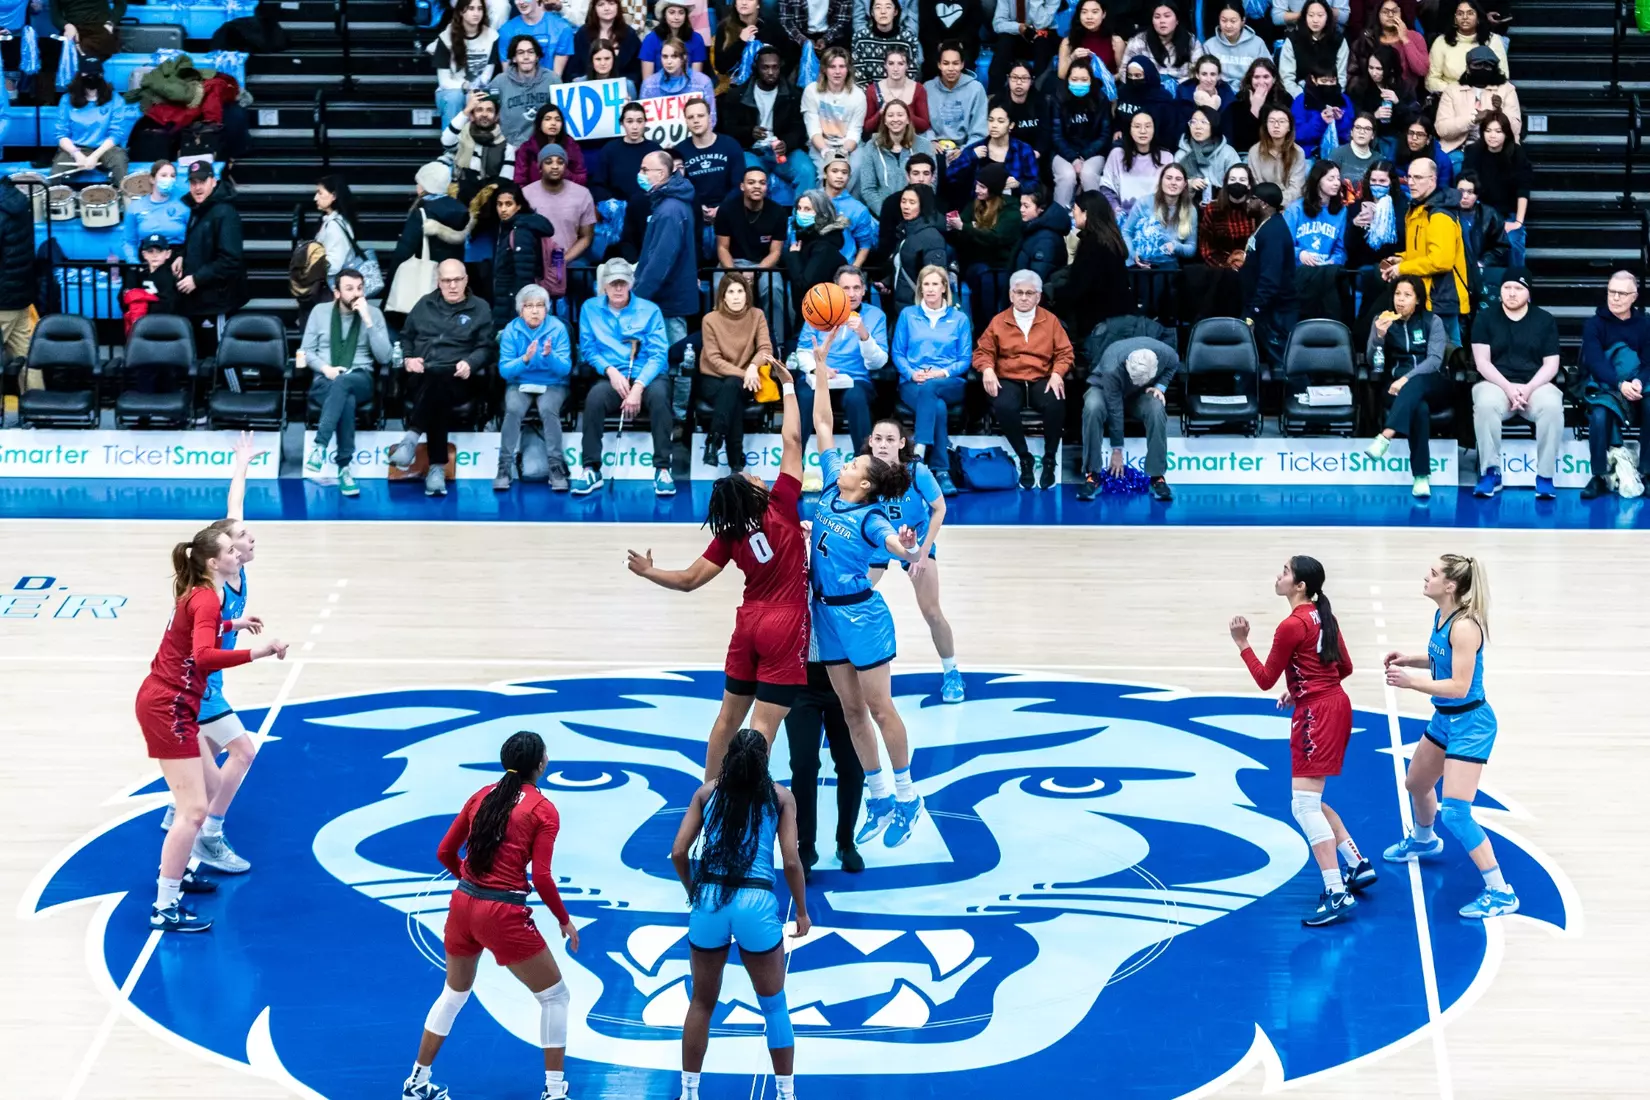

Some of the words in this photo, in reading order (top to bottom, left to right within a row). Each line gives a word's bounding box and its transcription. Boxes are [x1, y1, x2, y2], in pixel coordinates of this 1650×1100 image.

[556, 82, 625, 138] KD4
[1532, 116, 1543, 129] H
[1295, 220, 1340, 239] COLUMBI
[0, 445, 91, 464] marter
[102, 444, 271, 466] TicketSmarer
[1277, 451, 1449, 472] TicketSmarer
[748, 531, 774, 564] 0
[816, 530, 830, 559] 4
[13, 576, 69, 590] D.
